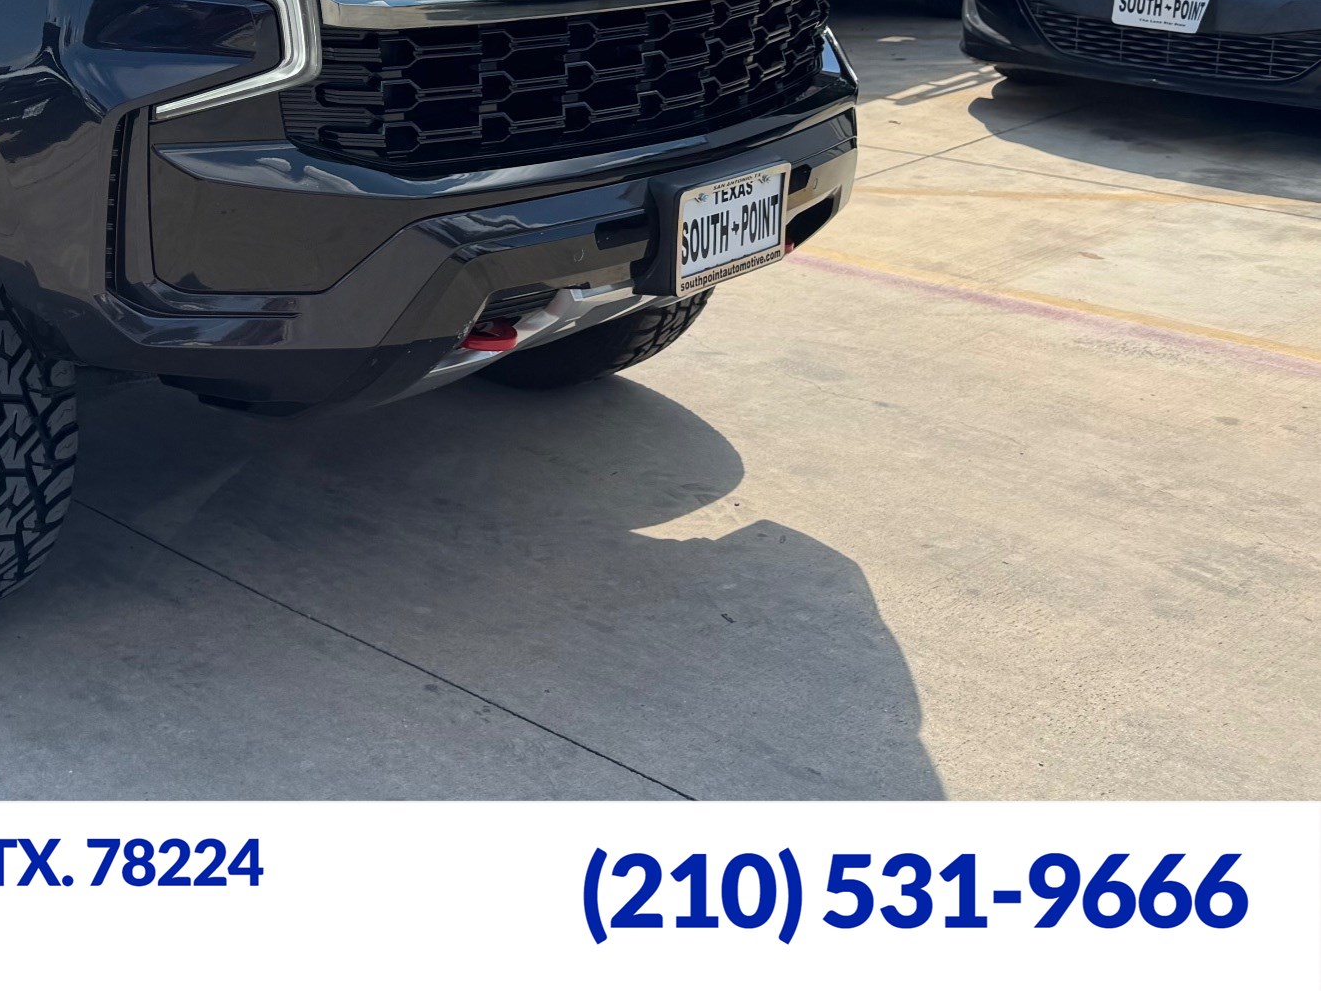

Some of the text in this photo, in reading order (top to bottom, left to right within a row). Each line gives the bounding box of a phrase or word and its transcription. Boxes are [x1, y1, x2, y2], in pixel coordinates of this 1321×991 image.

[1172, 0, 1206, 21] POINT
[713, 181, 754, 205] TEXAS
[681, 194, 779, 265] SOUTH POINT
[680, 249, 781, 292] southpointautomotive.com
